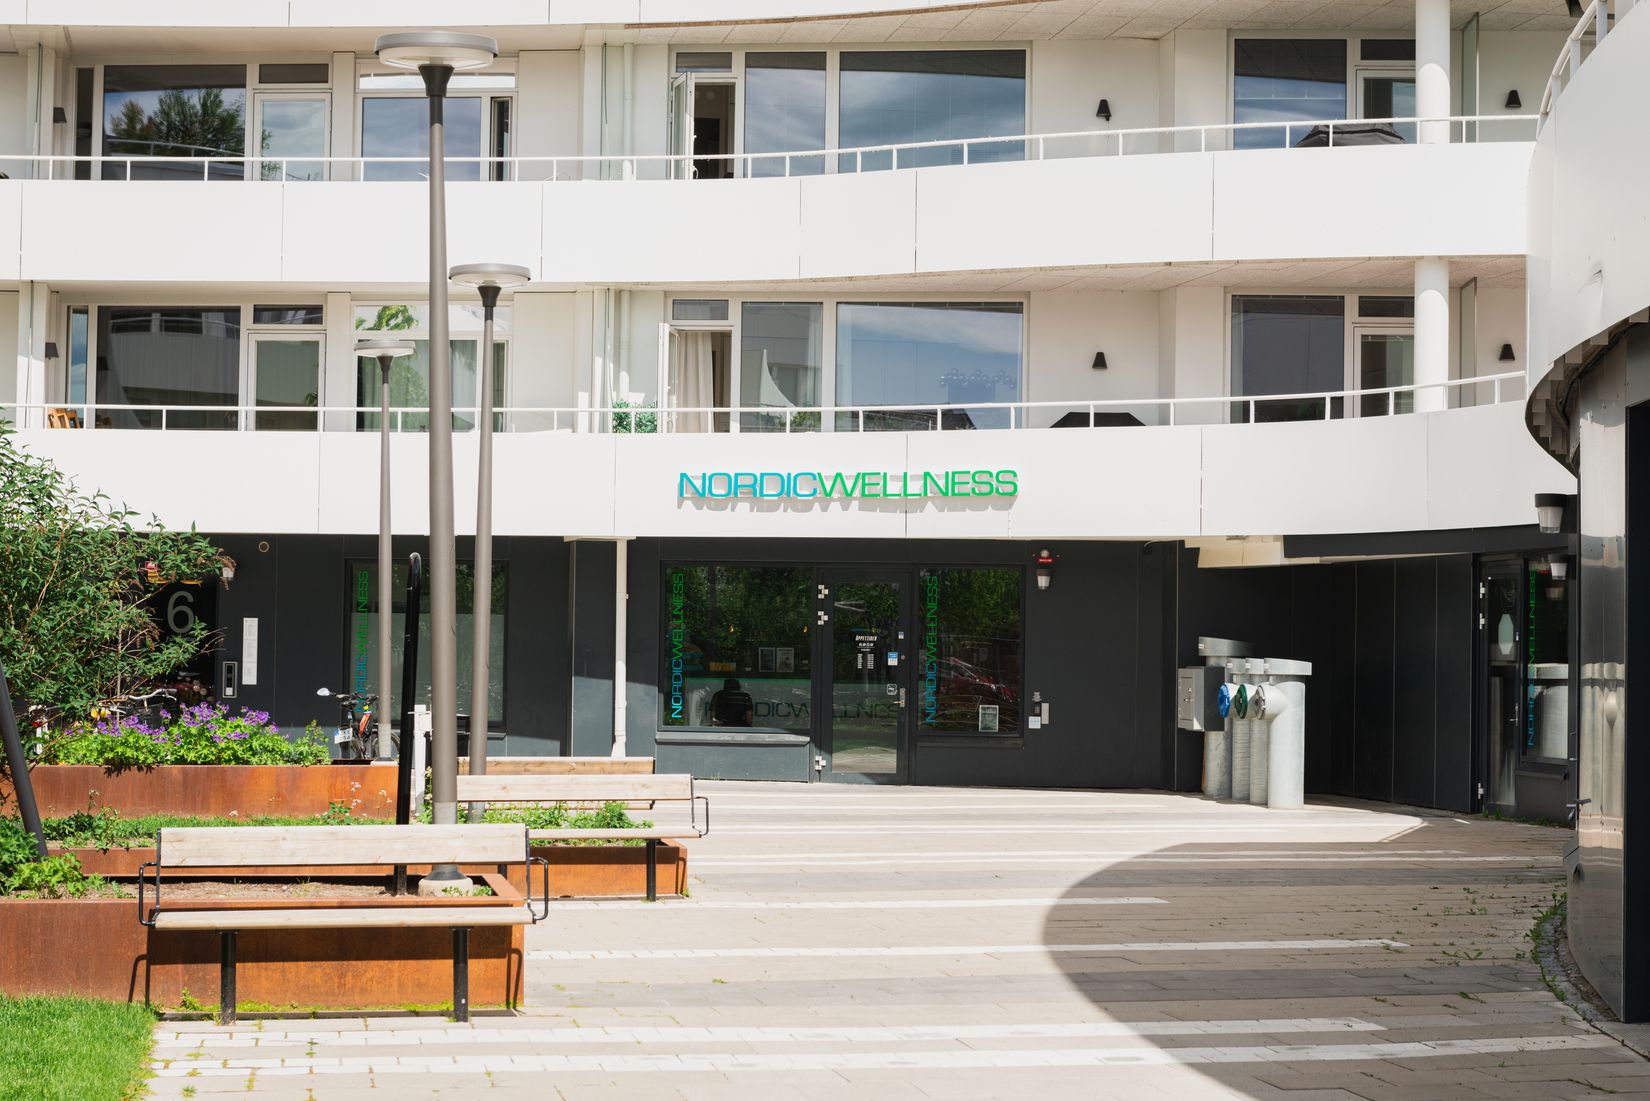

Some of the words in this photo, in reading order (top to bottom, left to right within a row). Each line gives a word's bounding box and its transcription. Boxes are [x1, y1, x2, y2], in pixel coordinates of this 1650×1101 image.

[679, 470, 1018, 497] NORDICWELLNESS
[167, 590, 194, 634] 6
[671, 572, 685, 719] NORDICWELLNESS
[925, 575, 938, 723] NORDICWELLNESS
